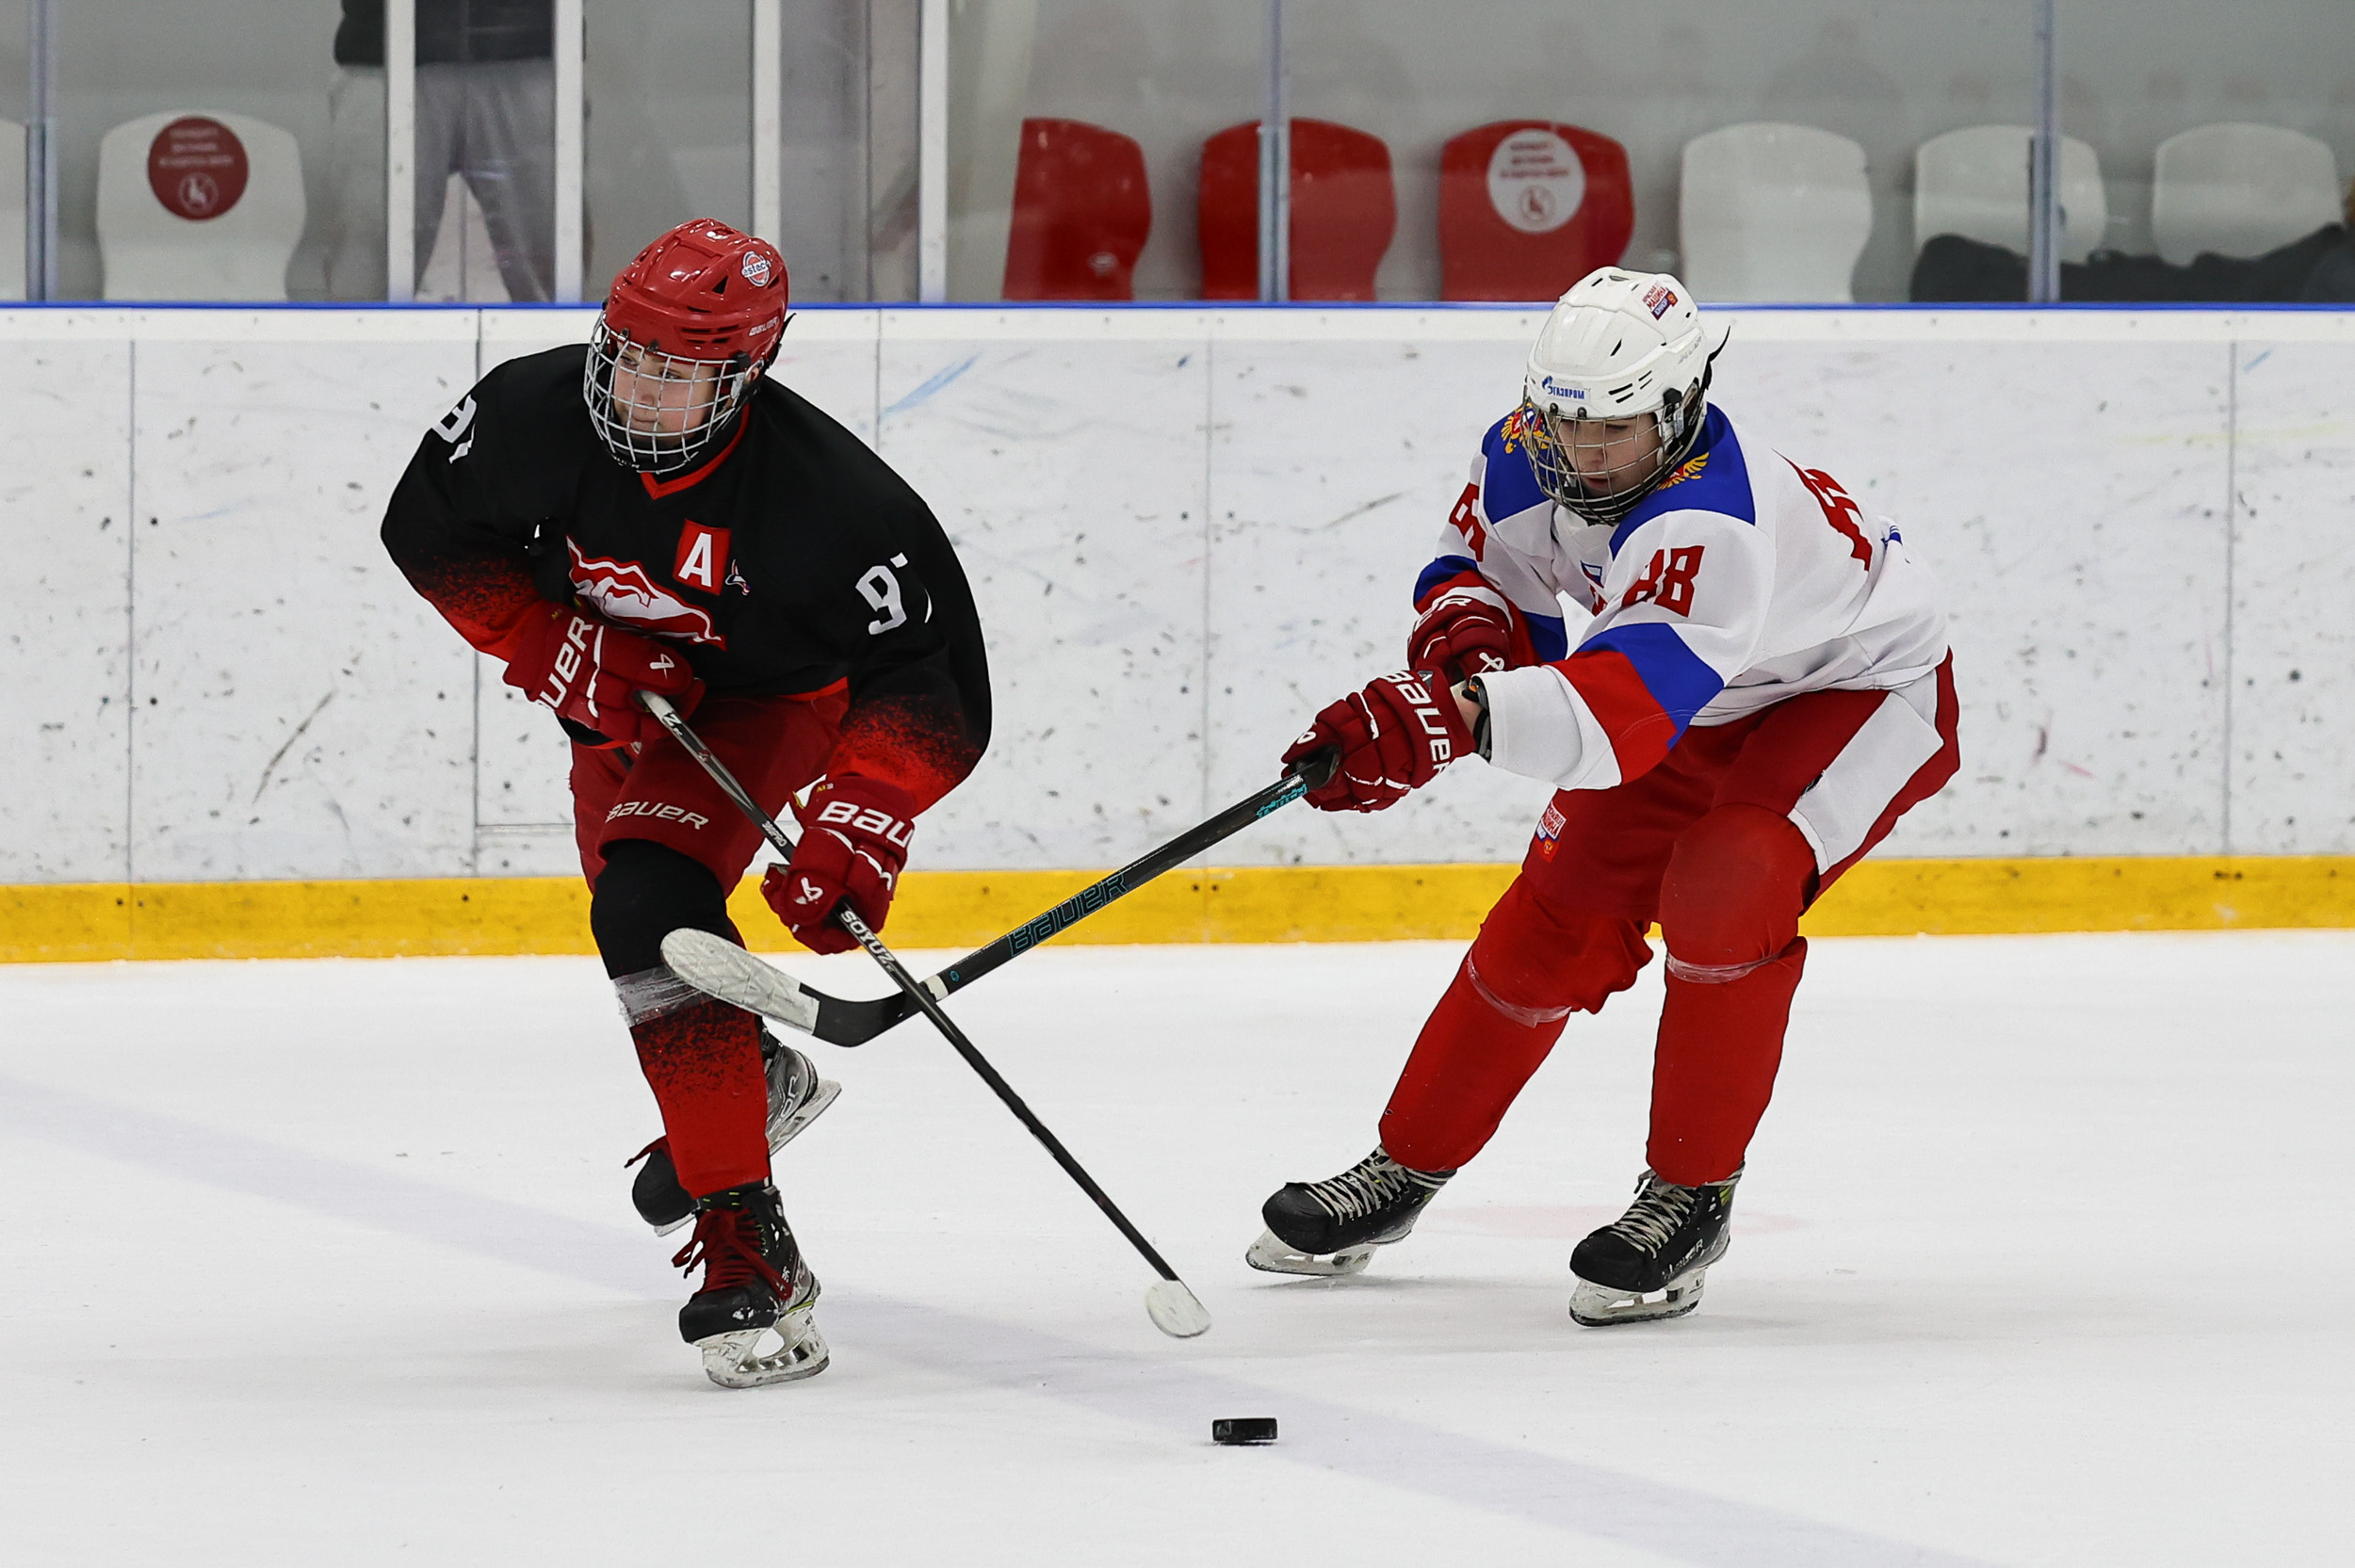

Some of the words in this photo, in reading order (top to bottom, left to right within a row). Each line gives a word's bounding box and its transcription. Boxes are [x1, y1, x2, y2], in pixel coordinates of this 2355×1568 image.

[1552, 386, 1585, 399] ГАЗПРОМ
[678, 532, 712, 588] A
[840, 909, 894, 968] SOYUZ
